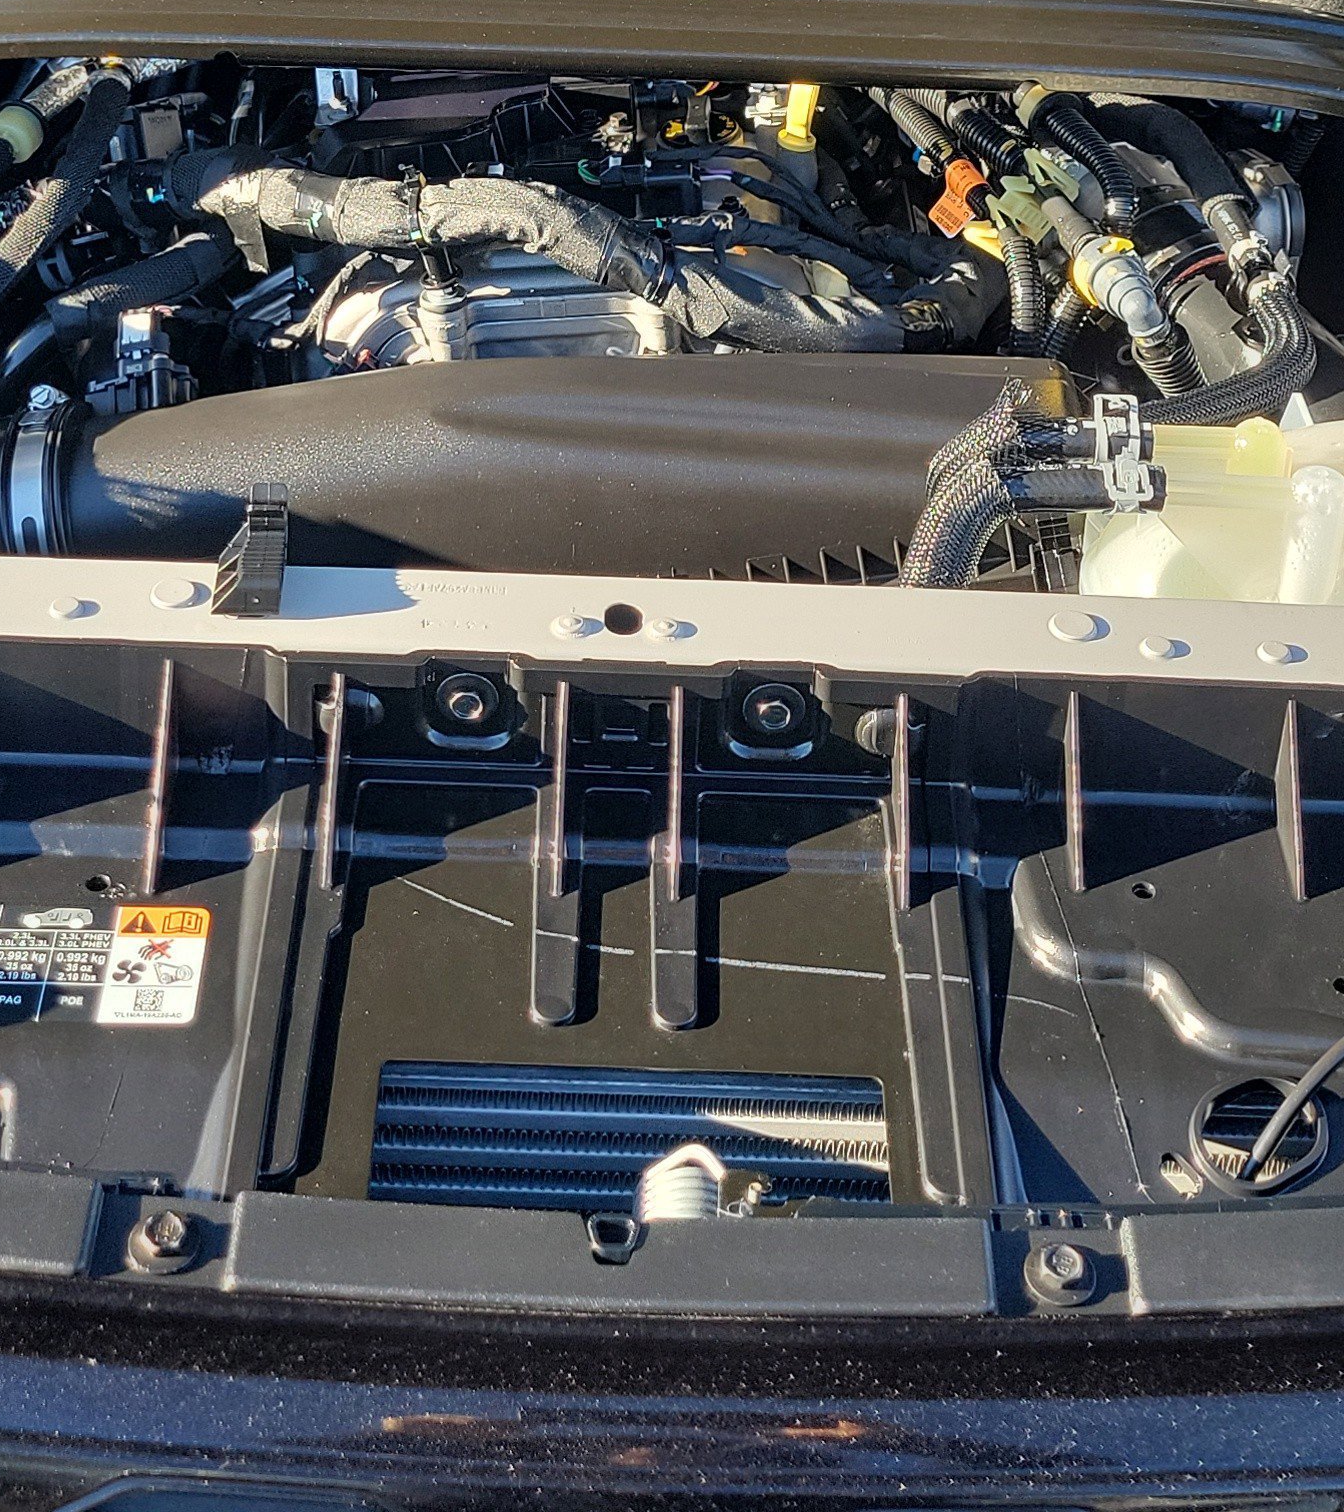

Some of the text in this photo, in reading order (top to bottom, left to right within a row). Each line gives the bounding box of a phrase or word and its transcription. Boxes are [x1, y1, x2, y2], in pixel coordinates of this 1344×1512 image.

[59, 933, 111, 941] 3.3L FHEV
[19, 939, 27, 947] &
[31, 952, 47, 963] kg
[56, 953, 106, 965] 0.992 kg
[21, 972, 37, 980] lbs
[81, 973, 97, 981] lbs
[60, 996, 84, 1006] POE
